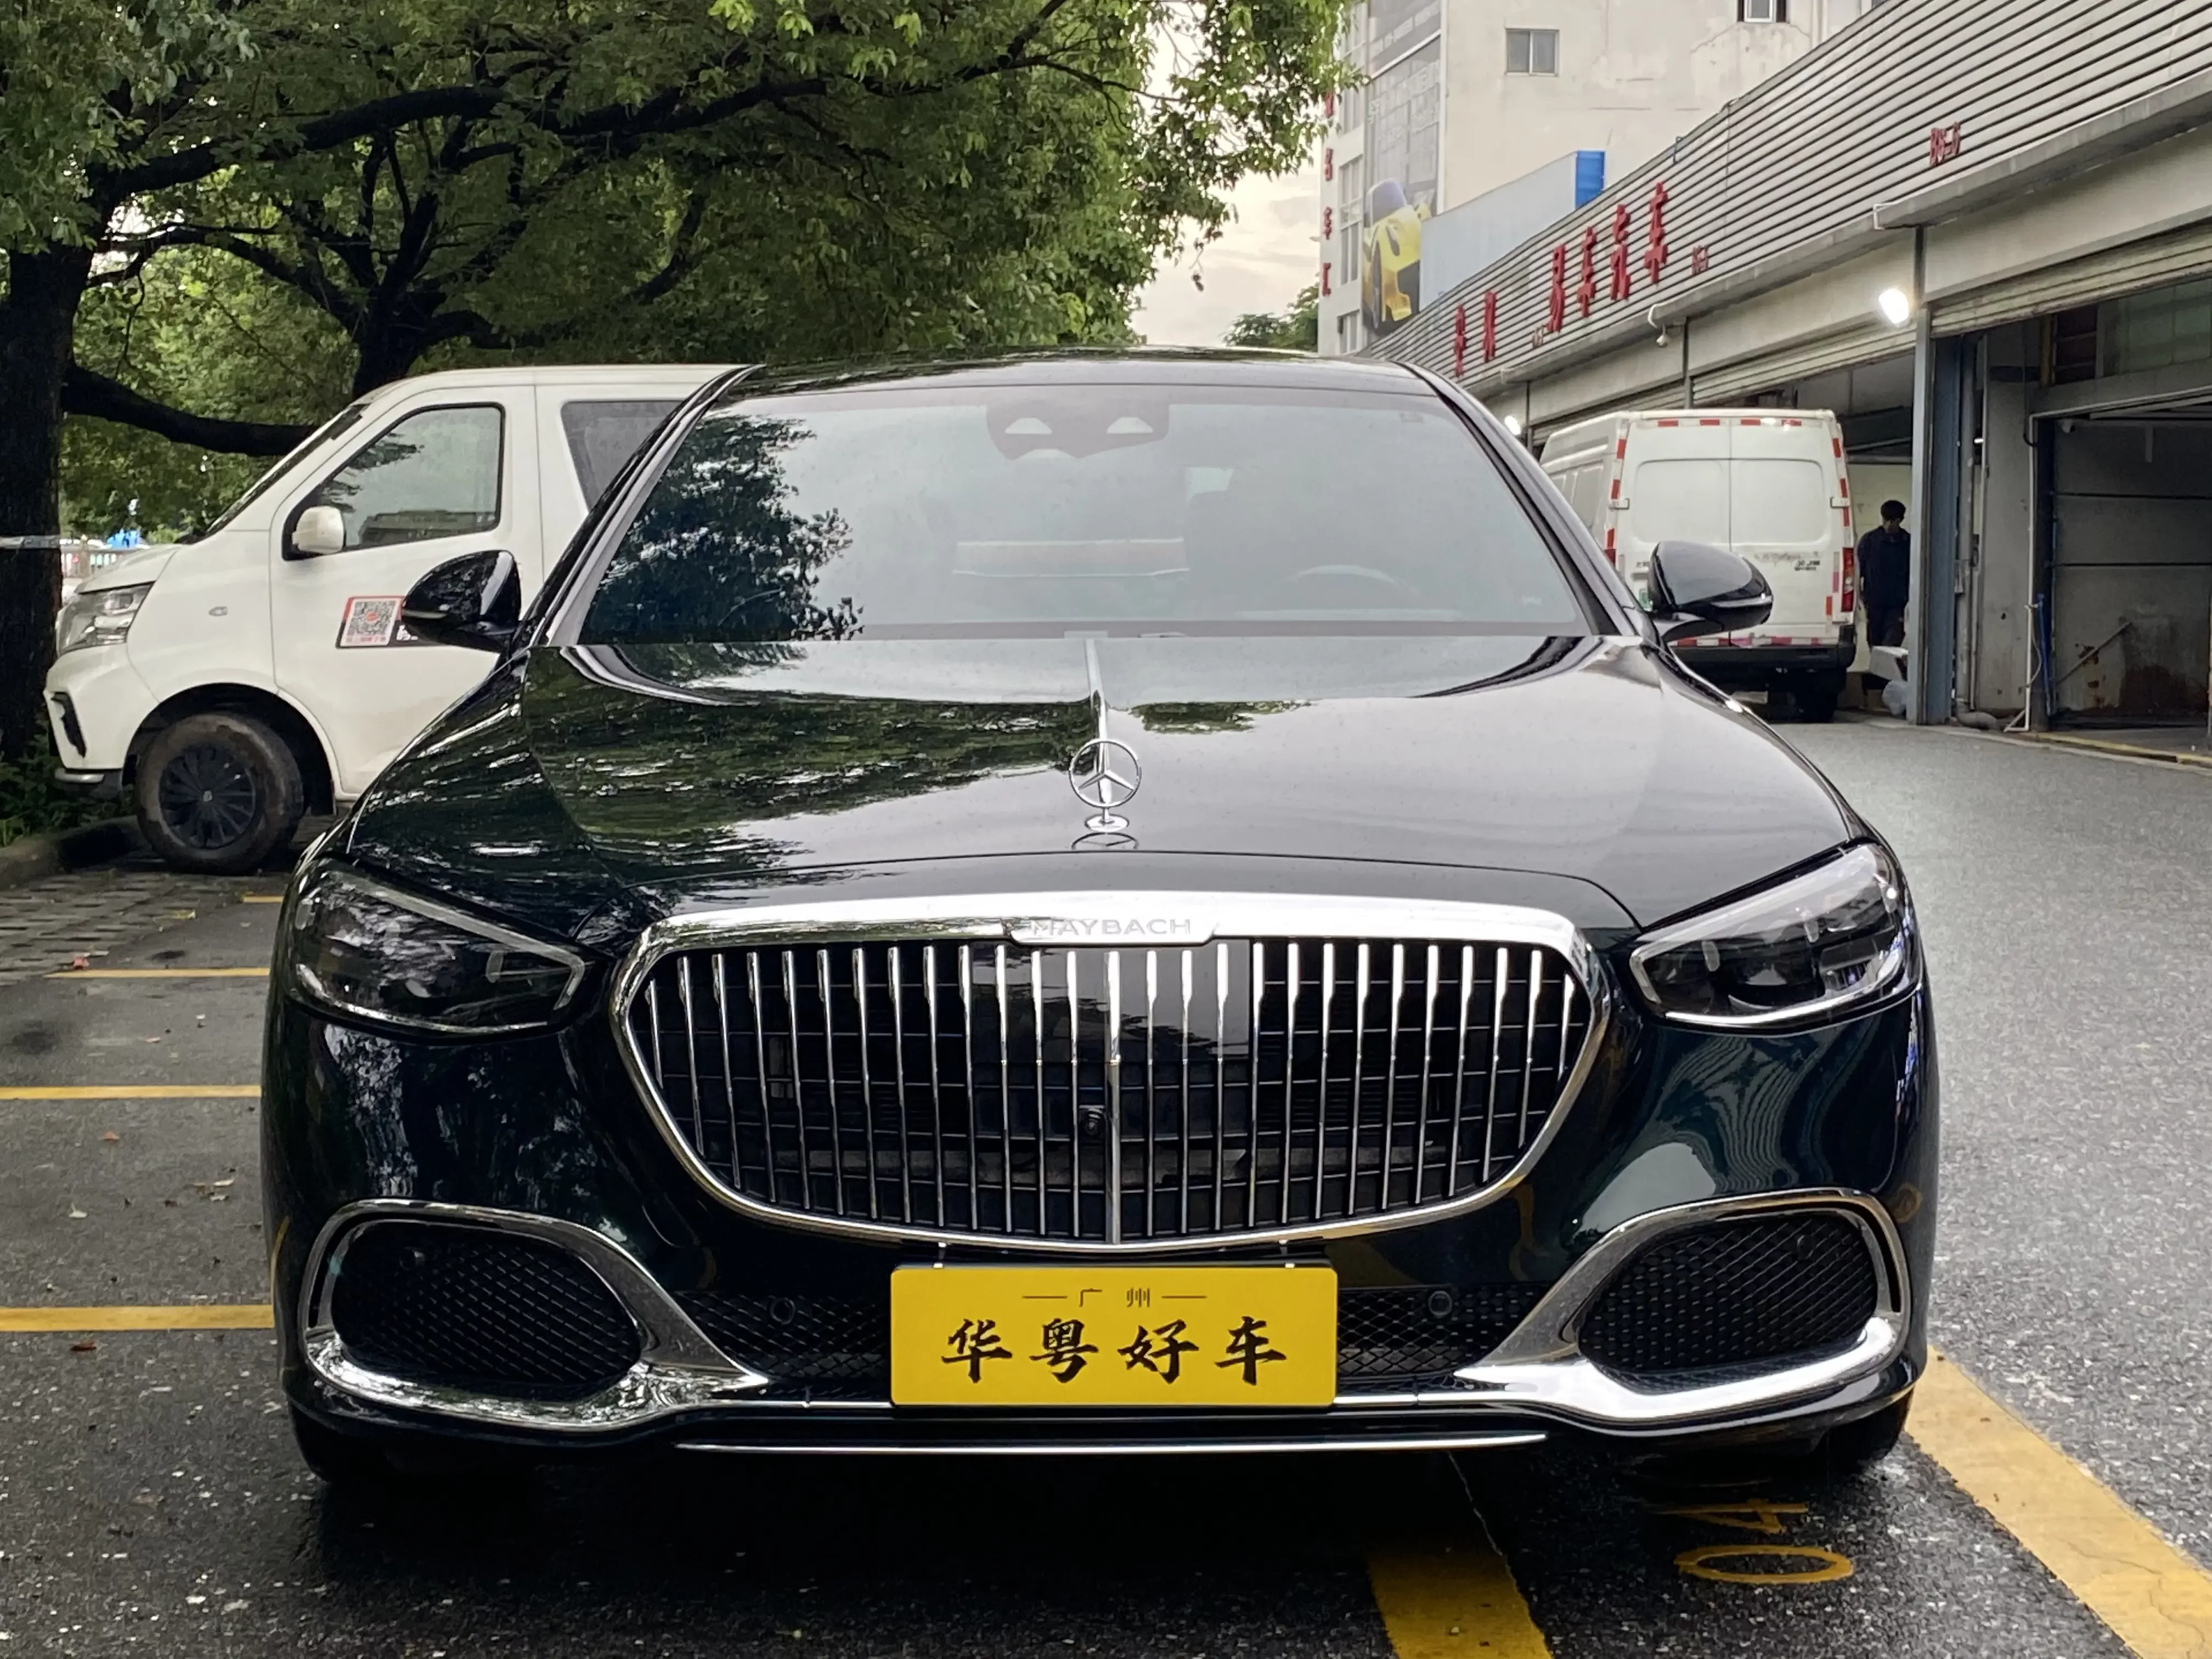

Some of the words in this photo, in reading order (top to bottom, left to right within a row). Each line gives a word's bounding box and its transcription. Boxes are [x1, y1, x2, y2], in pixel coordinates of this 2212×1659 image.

[1032, 919, 1190, 936] MAYBACH
[1079, 1287, 1150, 1308] 广州
[940, 1316, 1287, 1386] 华粤好车
